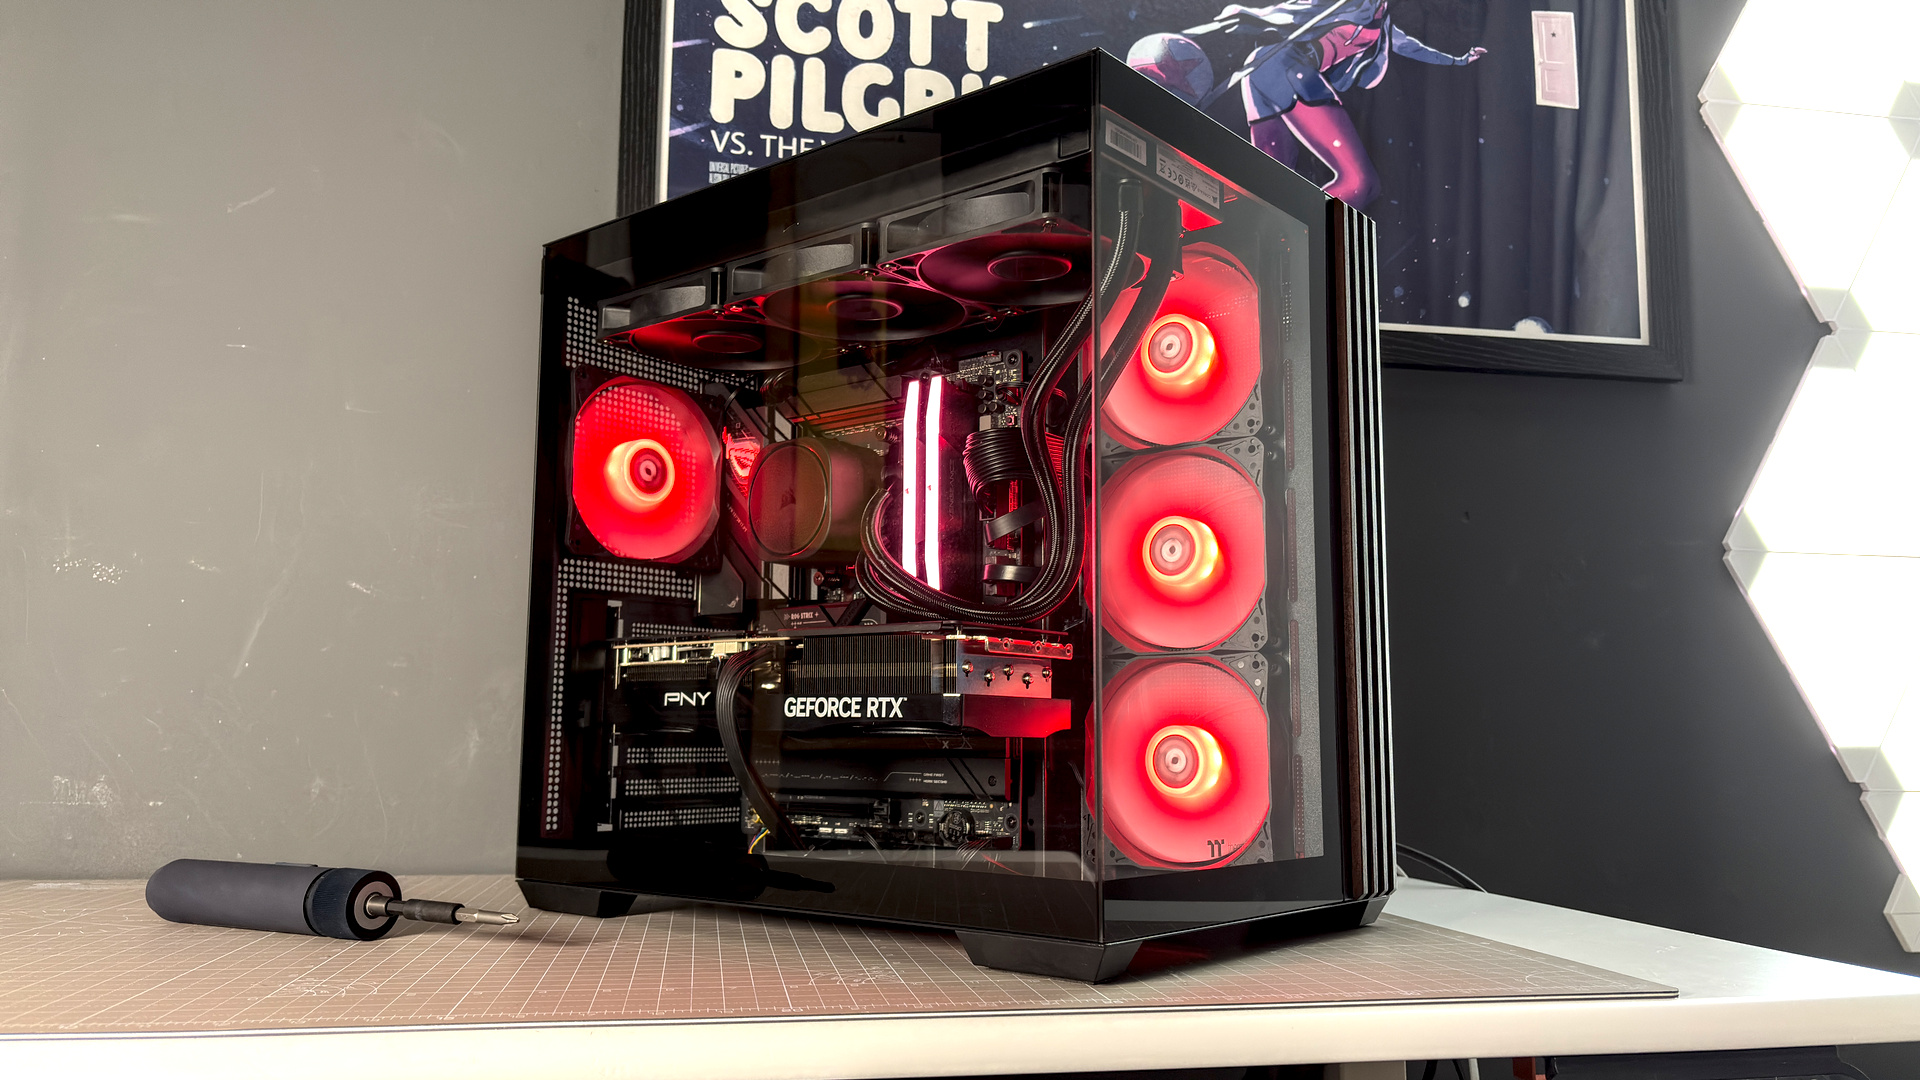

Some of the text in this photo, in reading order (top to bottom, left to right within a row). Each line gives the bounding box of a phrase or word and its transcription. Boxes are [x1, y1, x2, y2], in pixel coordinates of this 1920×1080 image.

[713, 0, 1004, 72] SCOTT
[710, 48, 1008, 133] PILGR
[710, 129, 754, 156] VS.
[664, 691, 711, 707] PNY
[784, 696, 862, 718] GEFORCE
